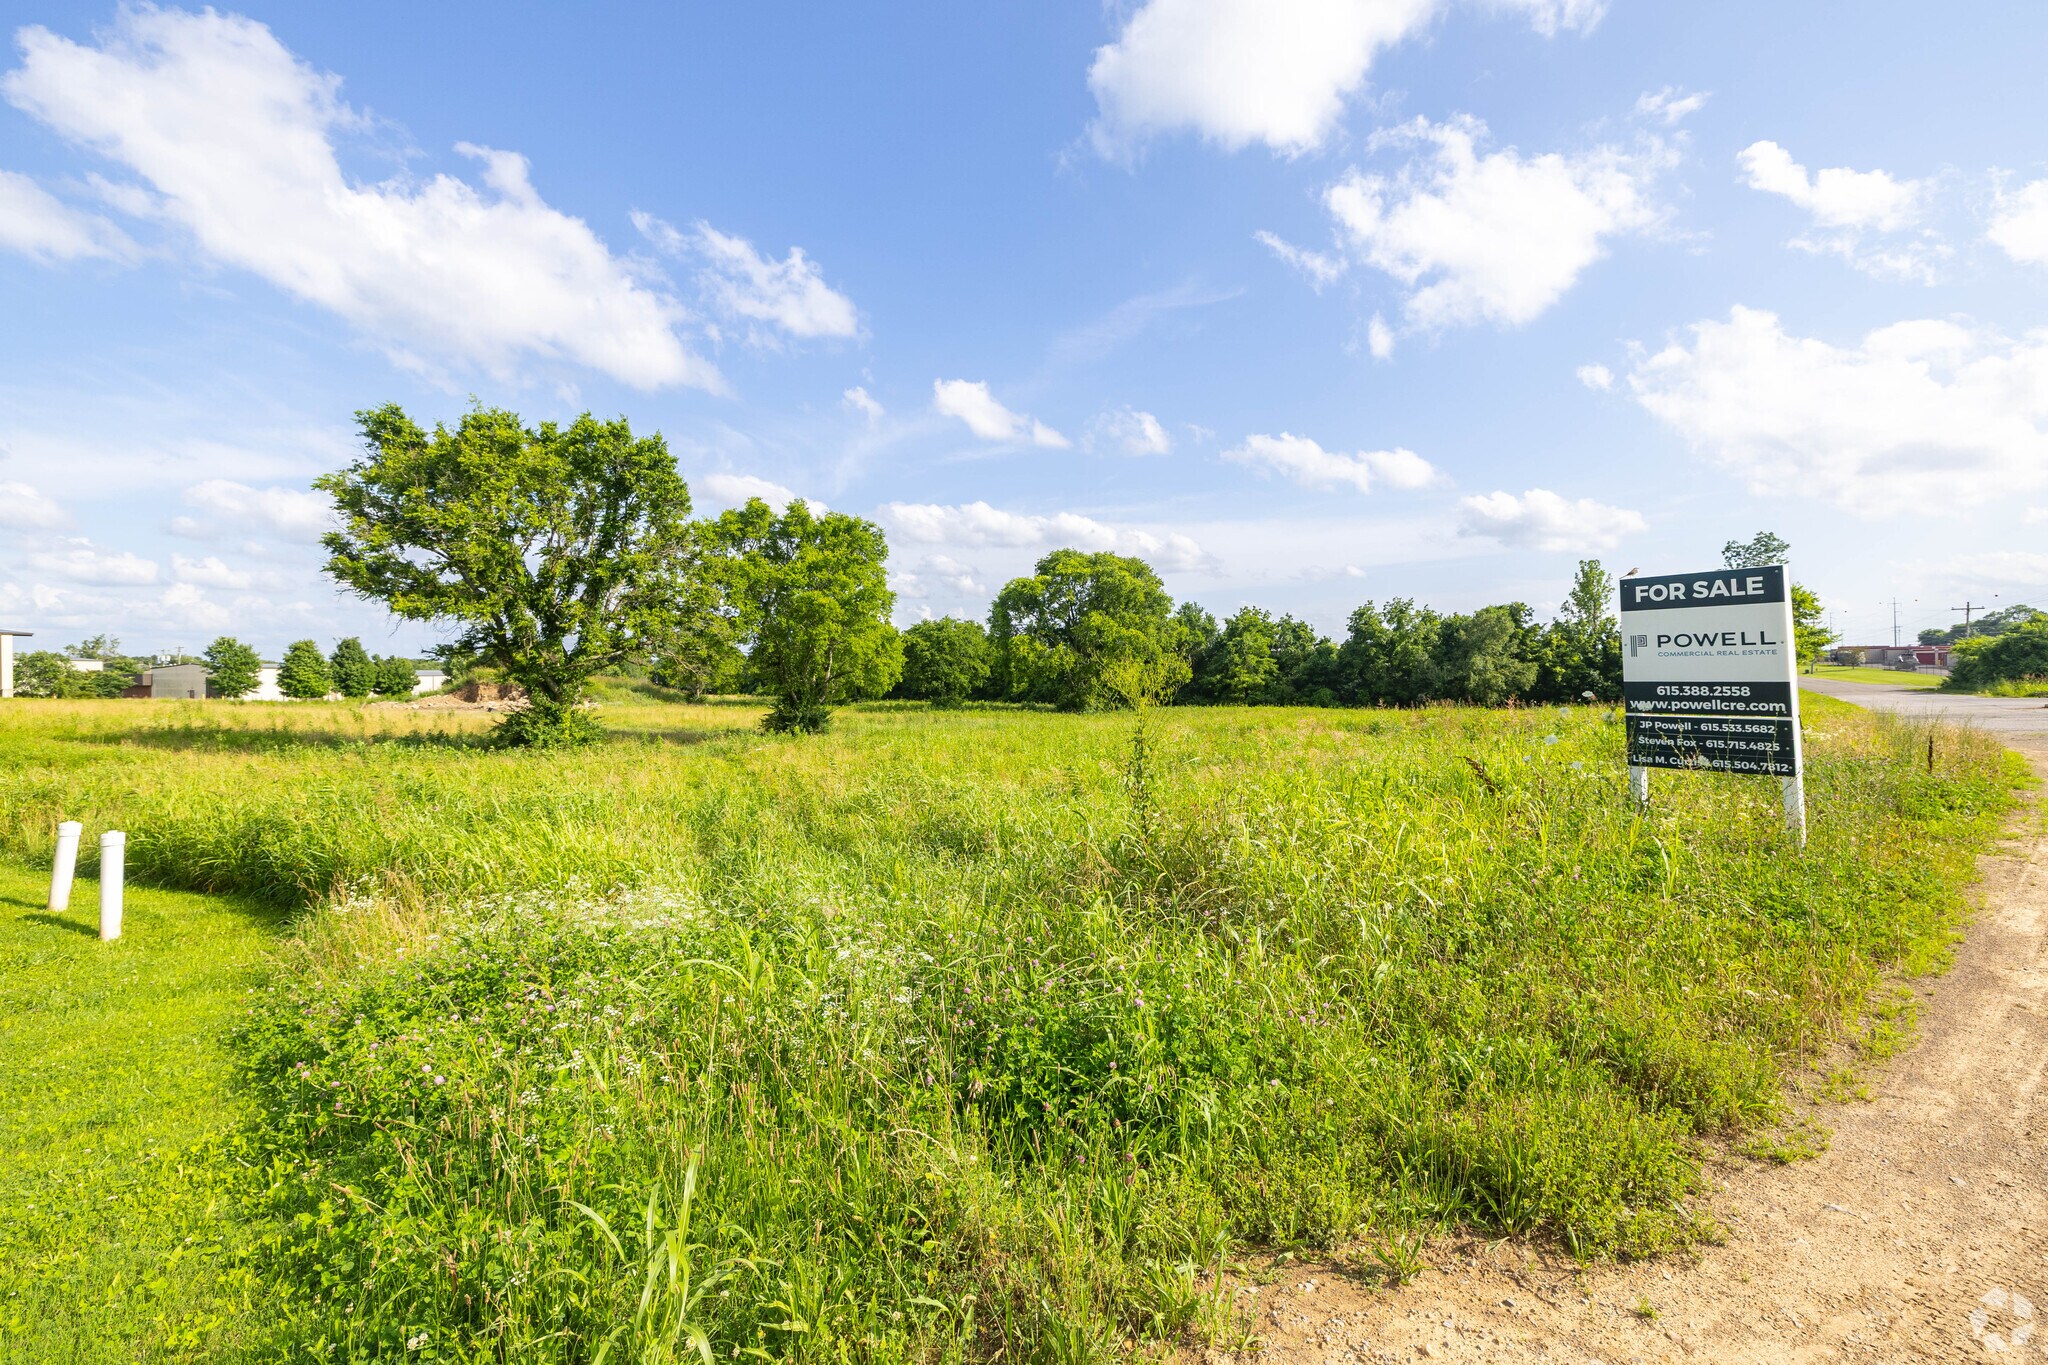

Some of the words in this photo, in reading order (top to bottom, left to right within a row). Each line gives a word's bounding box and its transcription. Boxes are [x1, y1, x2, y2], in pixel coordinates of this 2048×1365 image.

[1635, 583, 1686, 603] FOR
[1692, 576, 1764, 598] SALE
[1657, 631, 1776, 648] POWELL
[1657, 686, 1750, 696] 615.388.2558
[1655, 722, 1691, 730] Powell
[1701, 724, 1775, 733] 615.533.5682
[1639, 737, 1674, 745] Steven
[1706, 740, 1780, 751] 615.715.4825
[1656, 756, 1667, 764] M.
[1670, 757, 1702, 765] Curi
[1712, 760, 1789, 772] 615.504.7812
